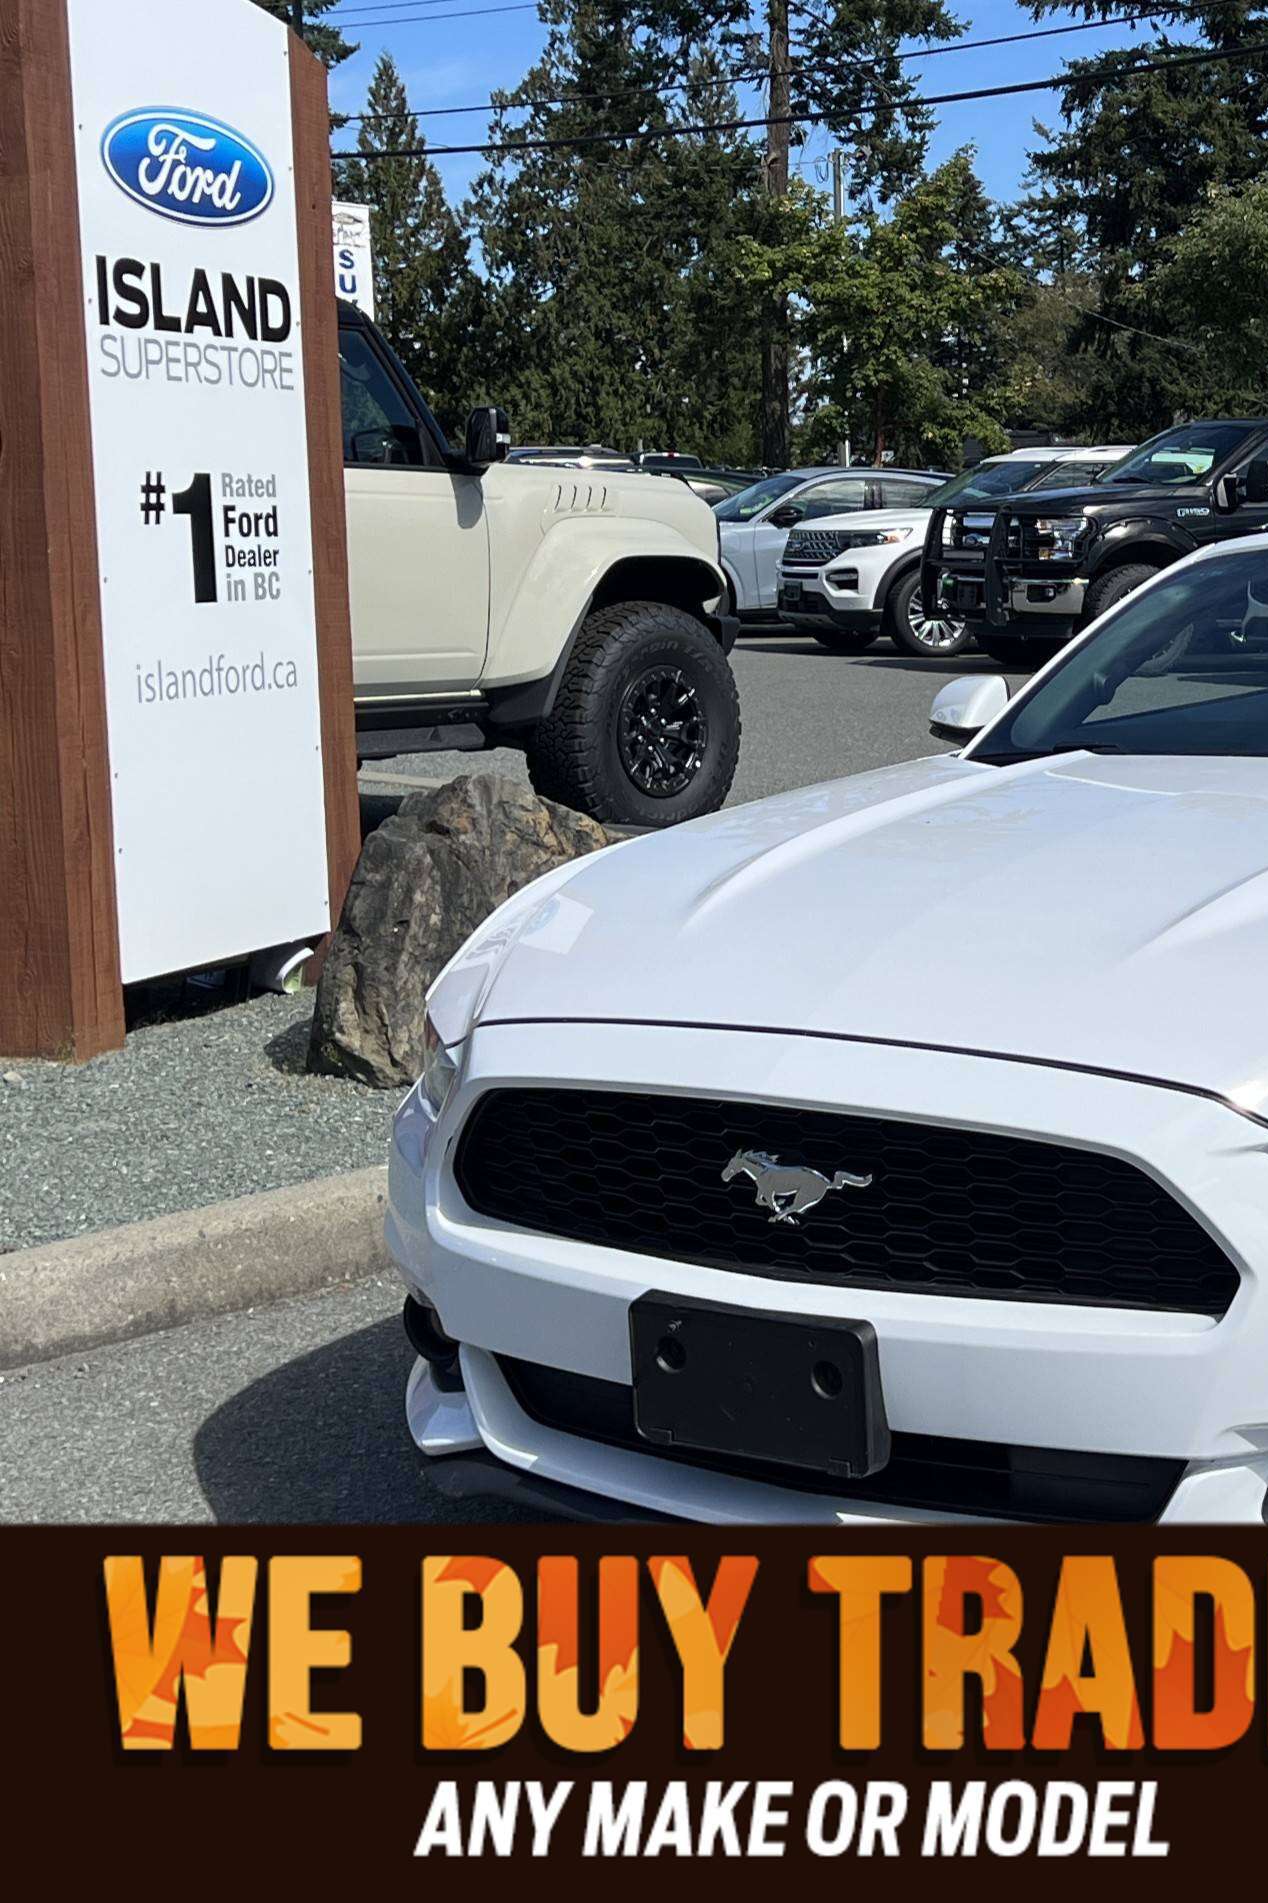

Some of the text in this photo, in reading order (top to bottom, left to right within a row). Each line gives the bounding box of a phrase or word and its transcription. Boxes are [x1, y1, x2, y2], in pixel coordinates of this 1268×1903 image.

[138, 123, 242, 211] Ford
[96, 255, 291, 343] ISLAND
[339, 248, 359, 304] SU
[100, 334, 294, 391] SUPERSTORE
[221, 472, 276, 498] Rated
[140, 471, 218, 603] #1
[223, 505, 279, 538] Ford
[224, 544, 279, 568] Dealer
[226, 571, 281, 601] in BC
[136, 651, 298, 704] islandford.ca
